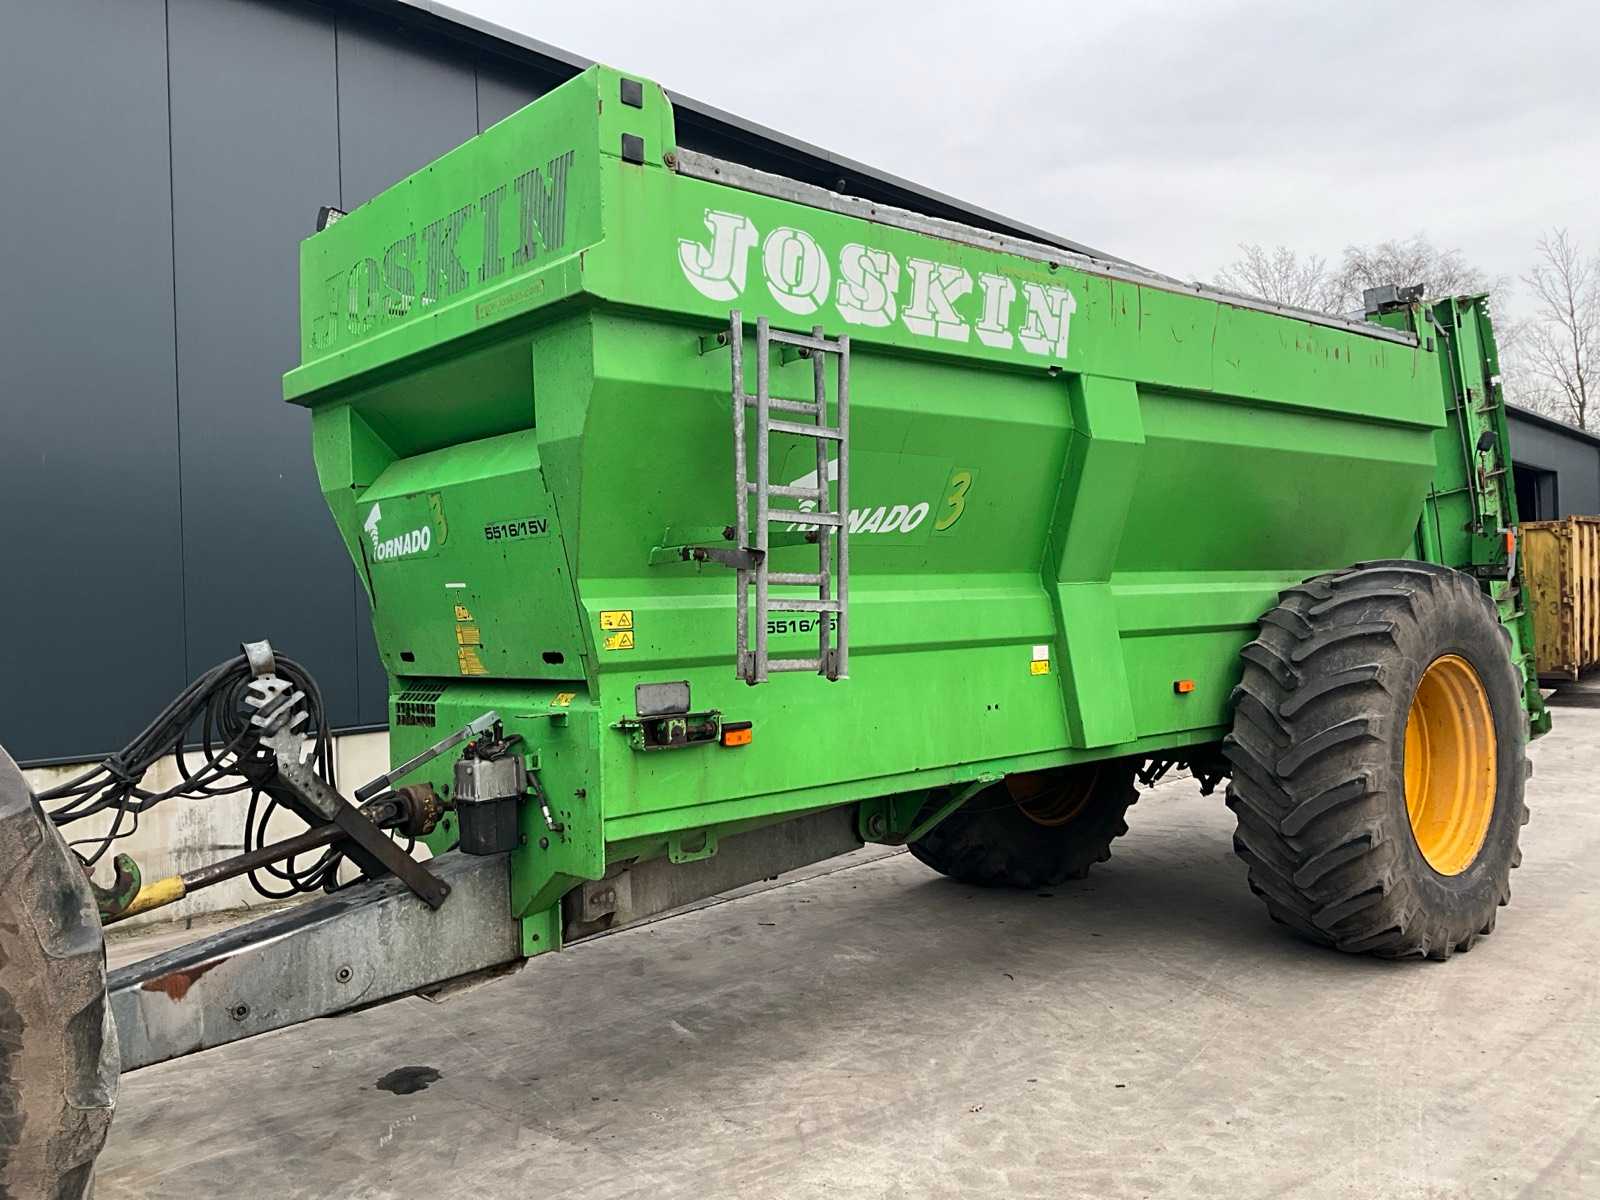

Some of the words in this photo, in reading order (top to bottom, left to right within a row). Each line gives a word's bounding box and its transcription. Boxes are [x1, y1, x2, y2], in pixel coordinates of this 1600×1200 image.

[309, 149, 575, 349] JOSKIN
[678, 208, 1077, 358] JOSKIN
[484, 519, 548, 541] 5516/15V
[934, 471, 972, 532] 3
[366, 507, 431, 561] TORNADO
